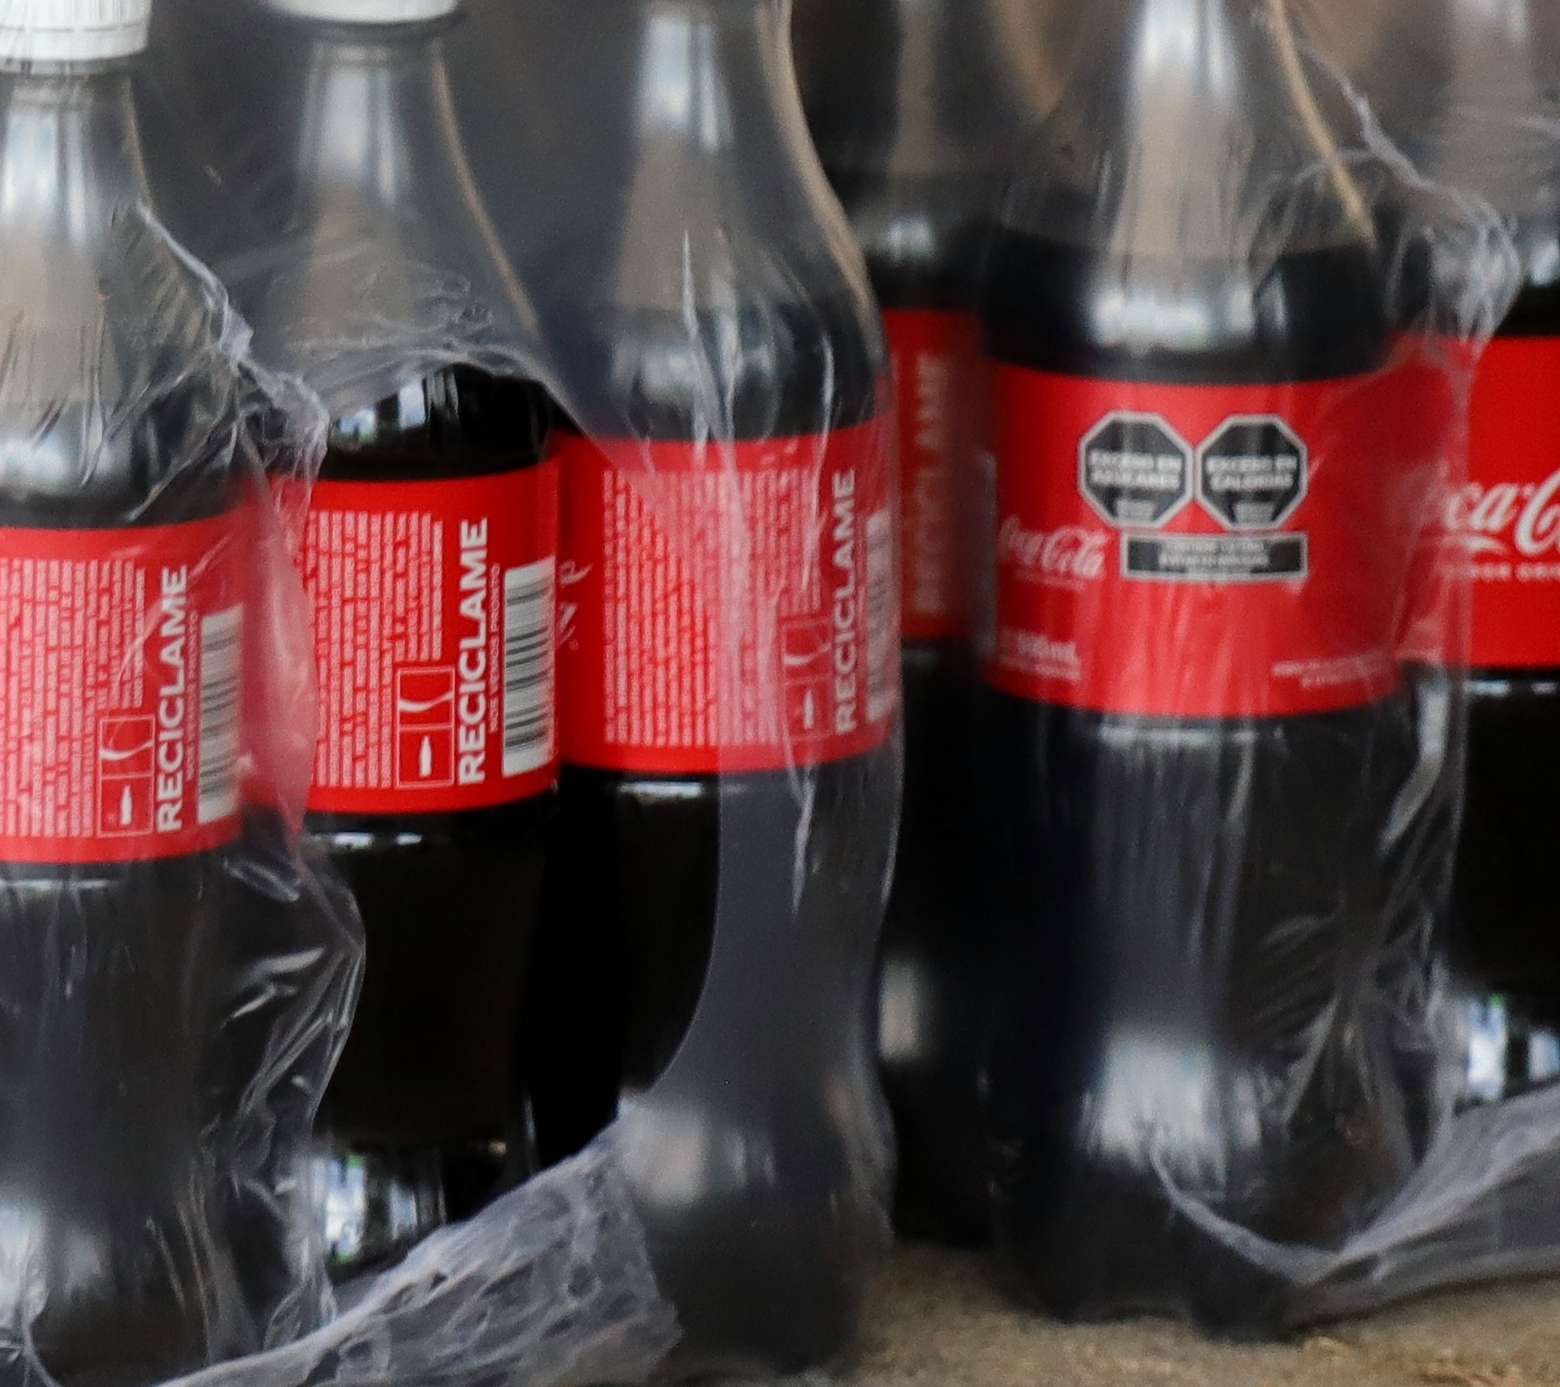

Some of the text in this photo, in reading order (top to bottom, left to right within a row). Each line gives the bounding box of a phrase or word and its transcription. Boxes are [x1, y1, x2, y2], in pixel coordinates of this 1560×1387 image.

[157, 564, 188, 833] RECICLAME
[457, 518, 488, 785] RECICLAME
[832, 468, 856, 733] RECICLAME
